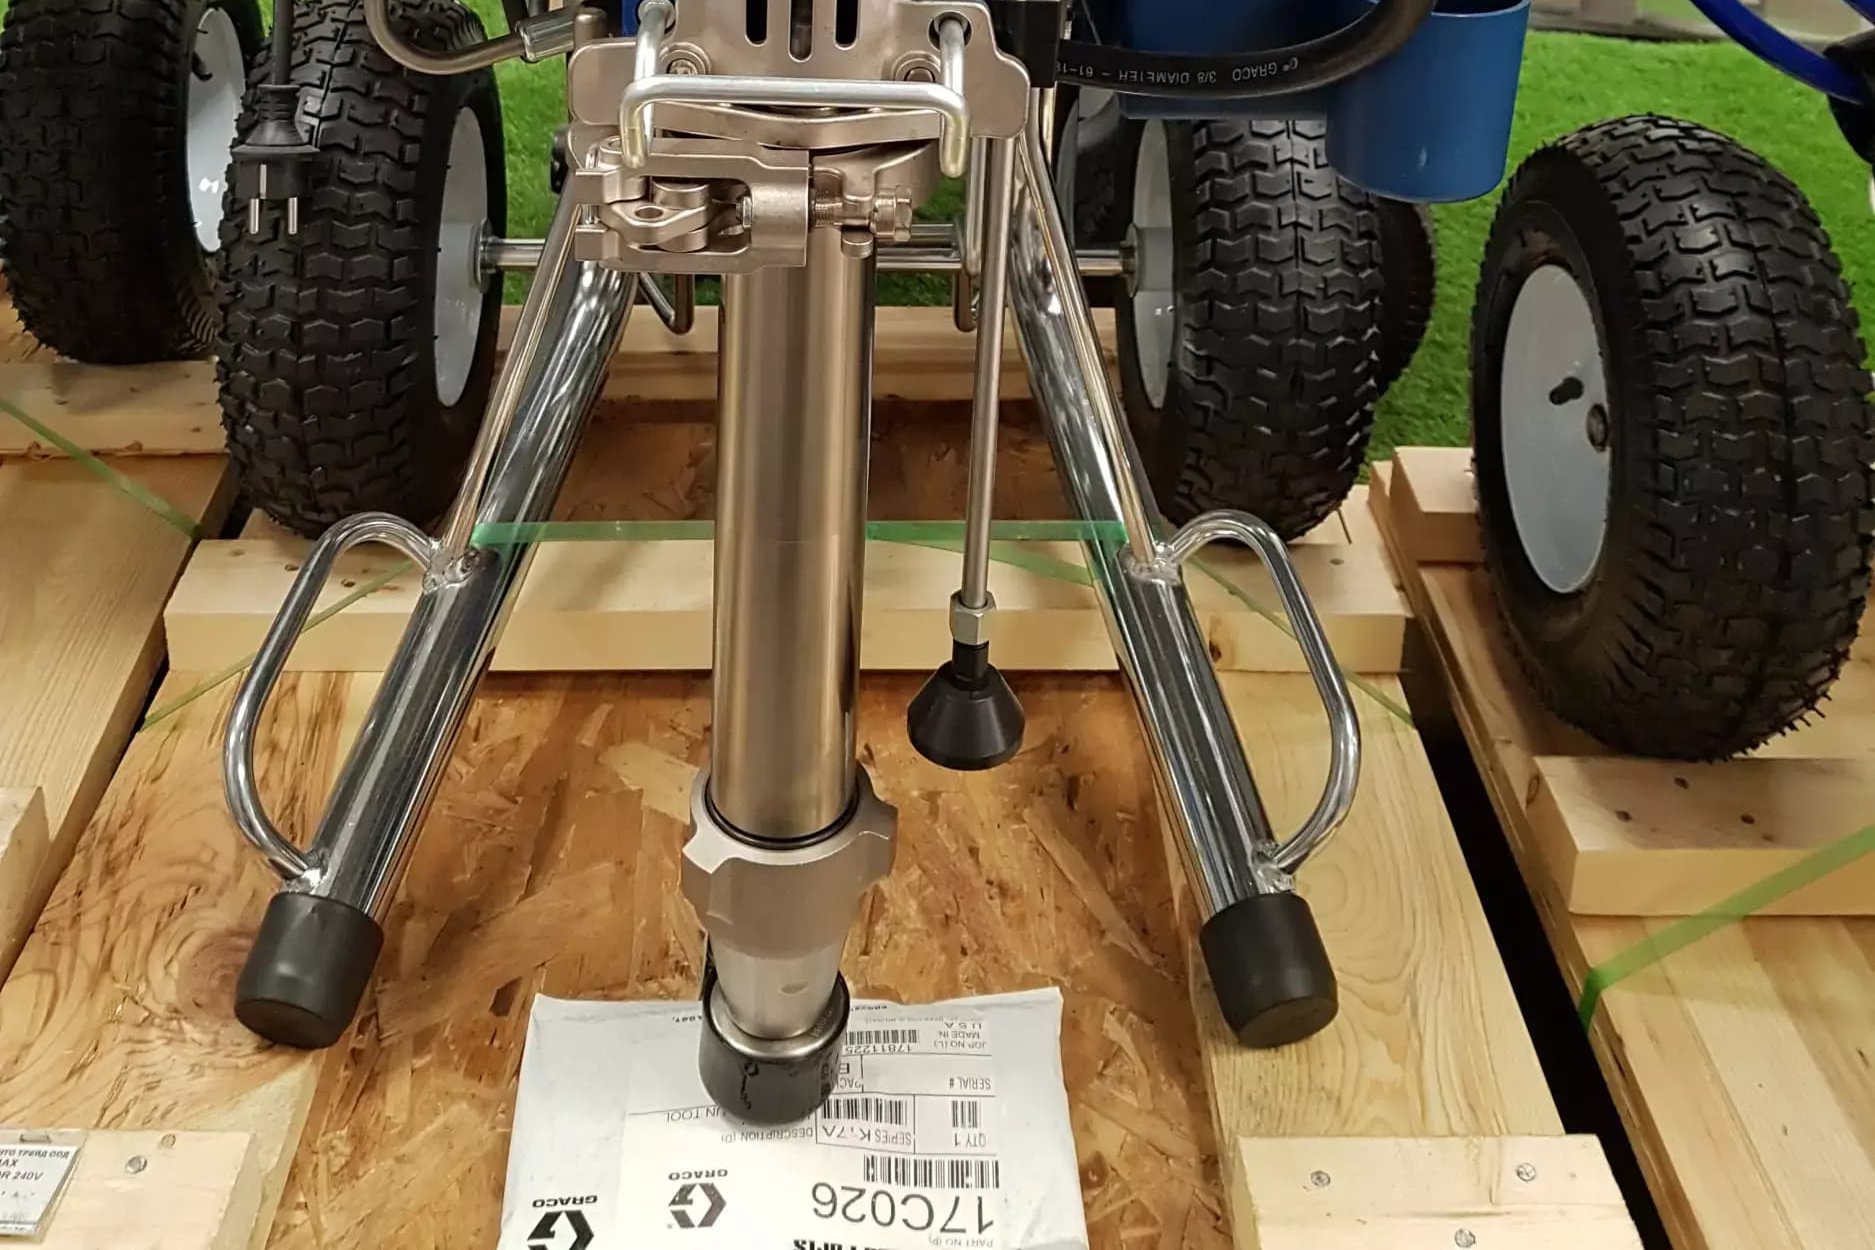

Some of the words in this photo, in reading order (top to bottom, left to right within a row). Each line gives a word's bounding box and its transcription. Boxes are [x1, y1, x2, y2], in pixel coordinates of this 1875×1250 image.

[1118, 68, 1190, 84] DIAMETER
[1198, 69, 1217, 84] 3/8
[1231, 61, 1278, 82] GRACO
[959, 1077, 992, 1091] SERIAL
[740, 1127, 815, 1142] DESCRIPTION
[953, 1133, 959, 1147] 1
[965, 1133, 987, 1148] QTY
[12, 1171, 44, 1181] 240V
[668, 1168, 729, 1181] GRACO
[531, 1194, 599, 1209] GRACO
[810, 1181, 995, 1235] 17C026
